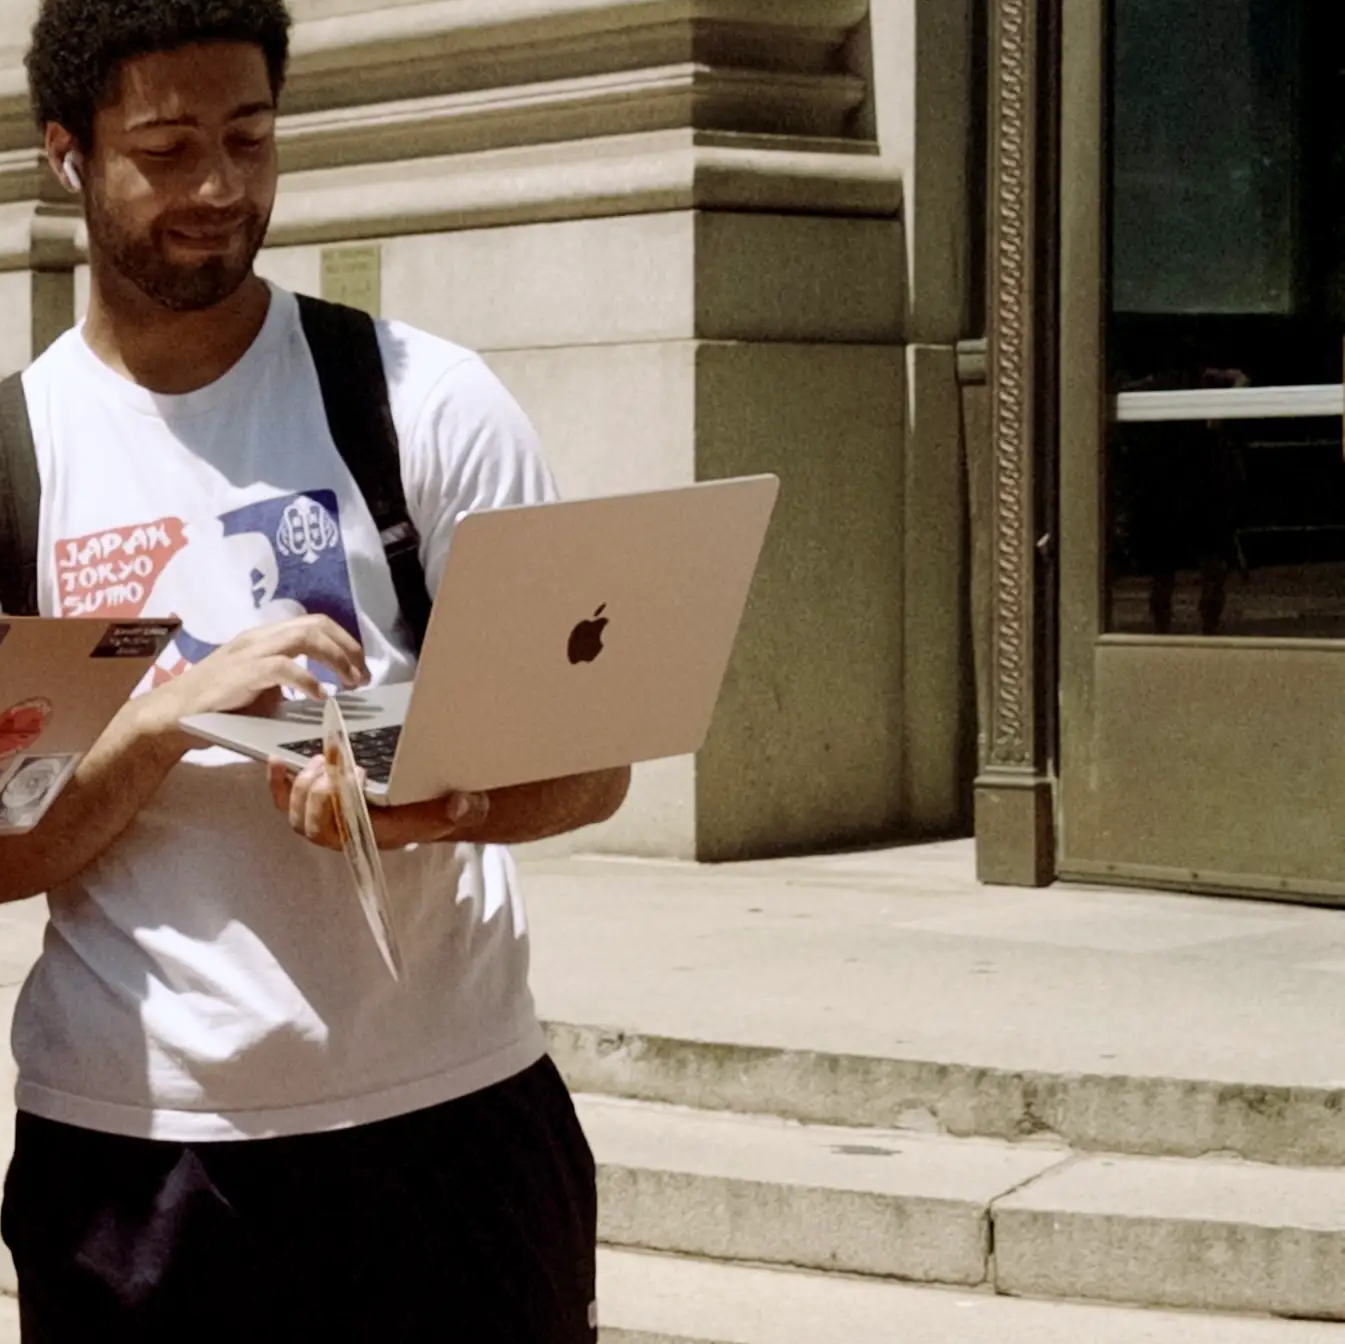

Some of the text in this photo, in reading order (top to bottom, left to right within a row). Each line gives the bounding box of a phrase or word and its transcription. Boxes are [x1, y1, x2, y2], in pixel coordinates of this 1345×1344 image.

[59, 523, 172, 568] JAPAN
[61, 554, 154, 593] TOKYO
[63, 582, 145, 617] SUMO
